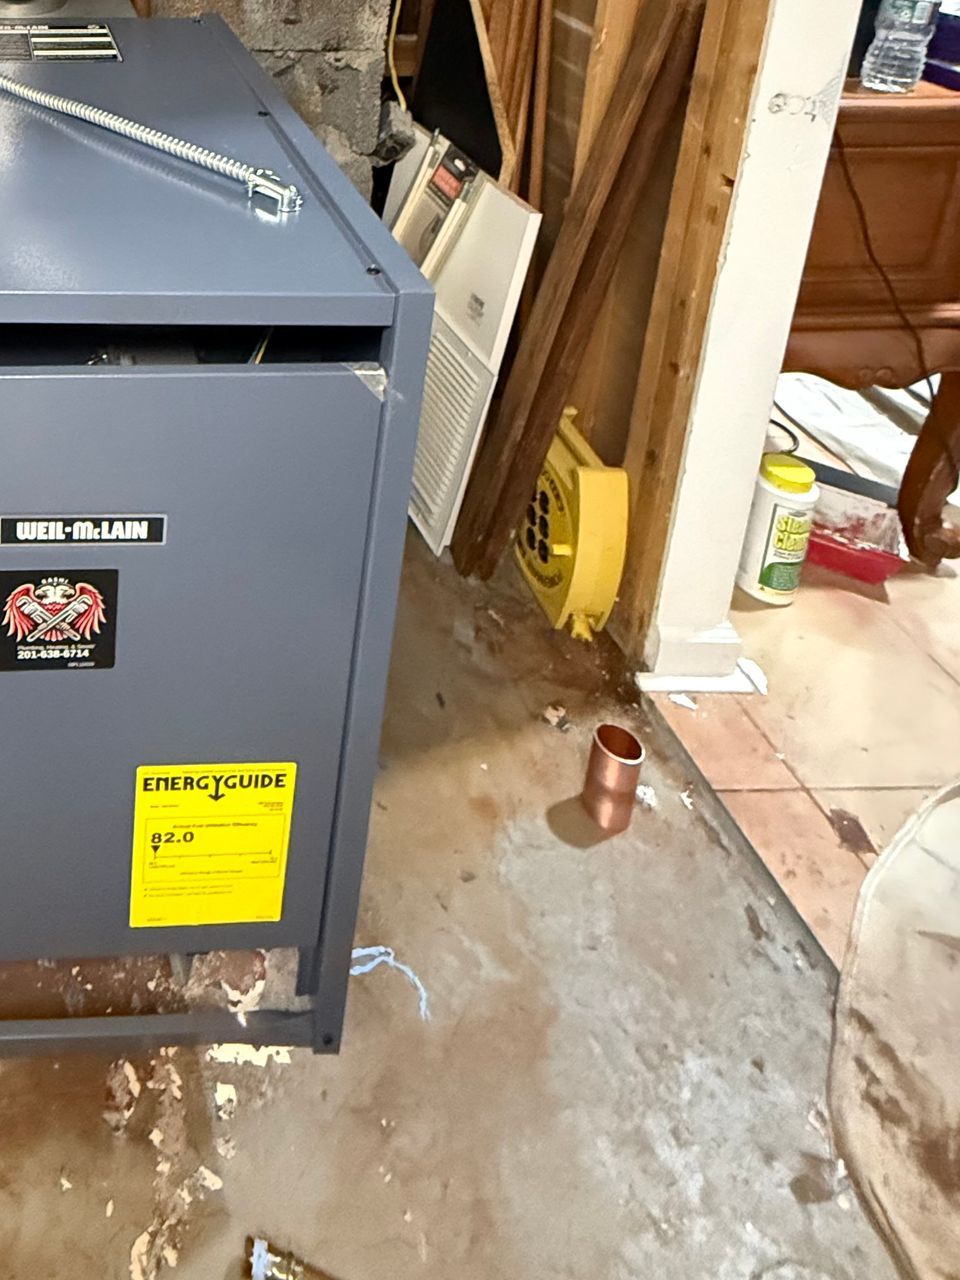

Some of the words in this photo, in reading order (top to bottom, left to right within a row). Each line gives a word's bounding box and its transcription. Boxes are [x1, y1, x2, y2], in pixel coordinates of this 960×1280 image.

[16, 521, 149, 540] WEIL-McLAIN
[17, 648, 90, 660] 201-638-6714
[143, 773, 287, 798] ENERGYGUIDE
[151, 831, 194, 844] 82.0
